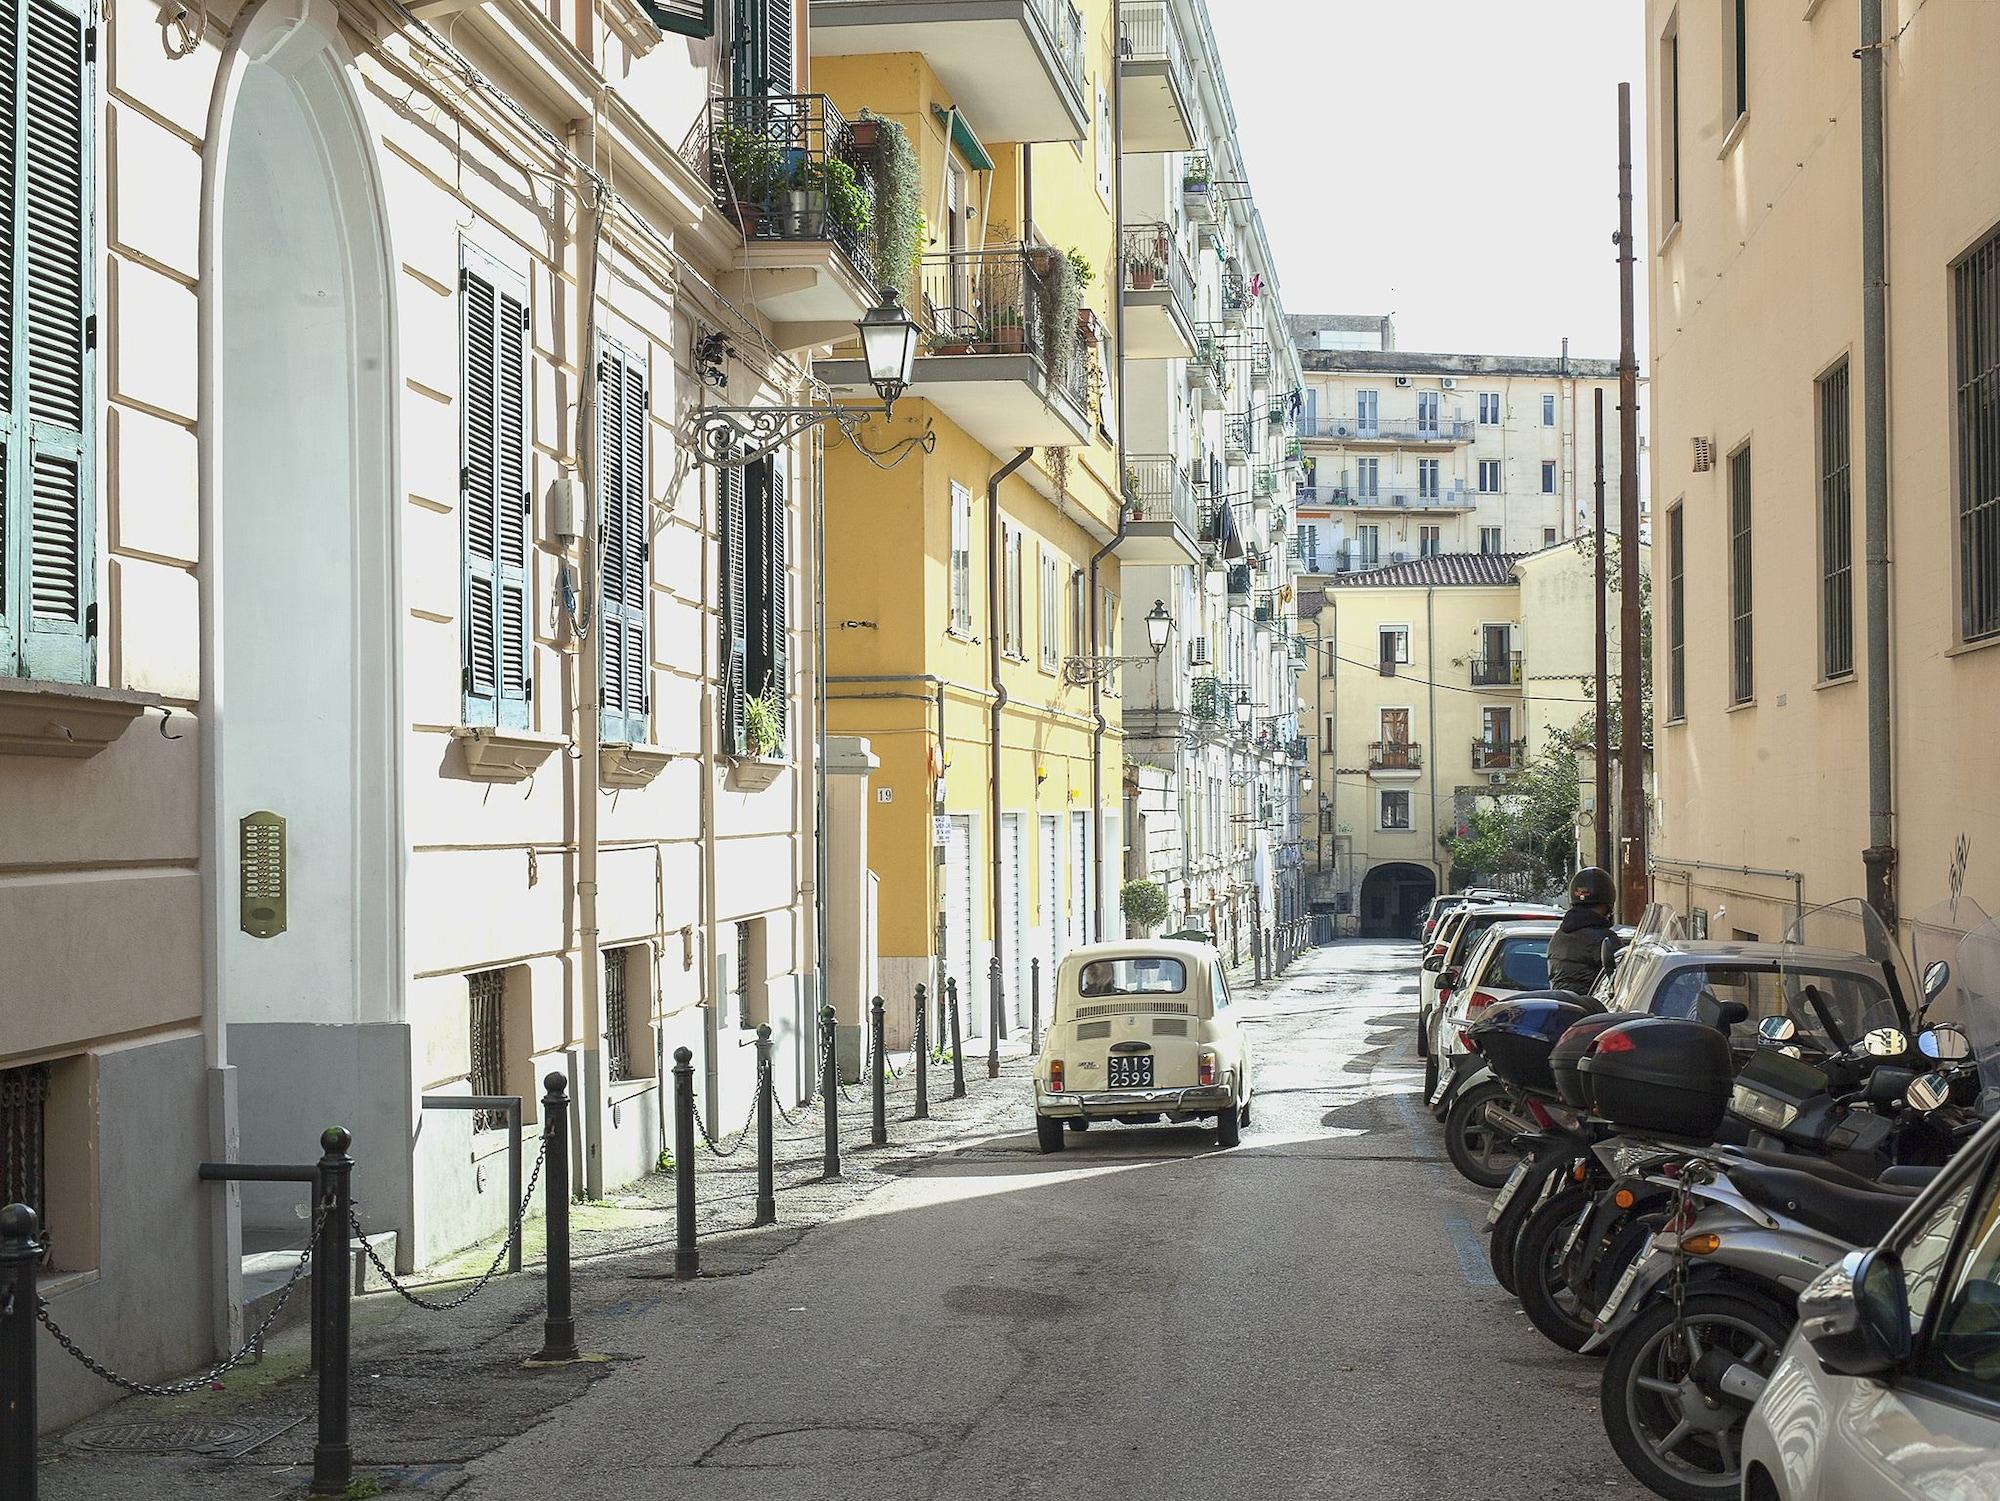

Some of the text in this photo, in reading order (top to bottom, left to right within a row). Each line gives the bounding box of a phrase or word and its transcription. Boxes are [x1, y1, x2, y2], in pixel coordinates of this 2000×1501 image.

[879, 789, 891, 801] 19
[1110, 1057, 1151, 1071] SA19
[1110, 1072, 1151, 1087] 2599
